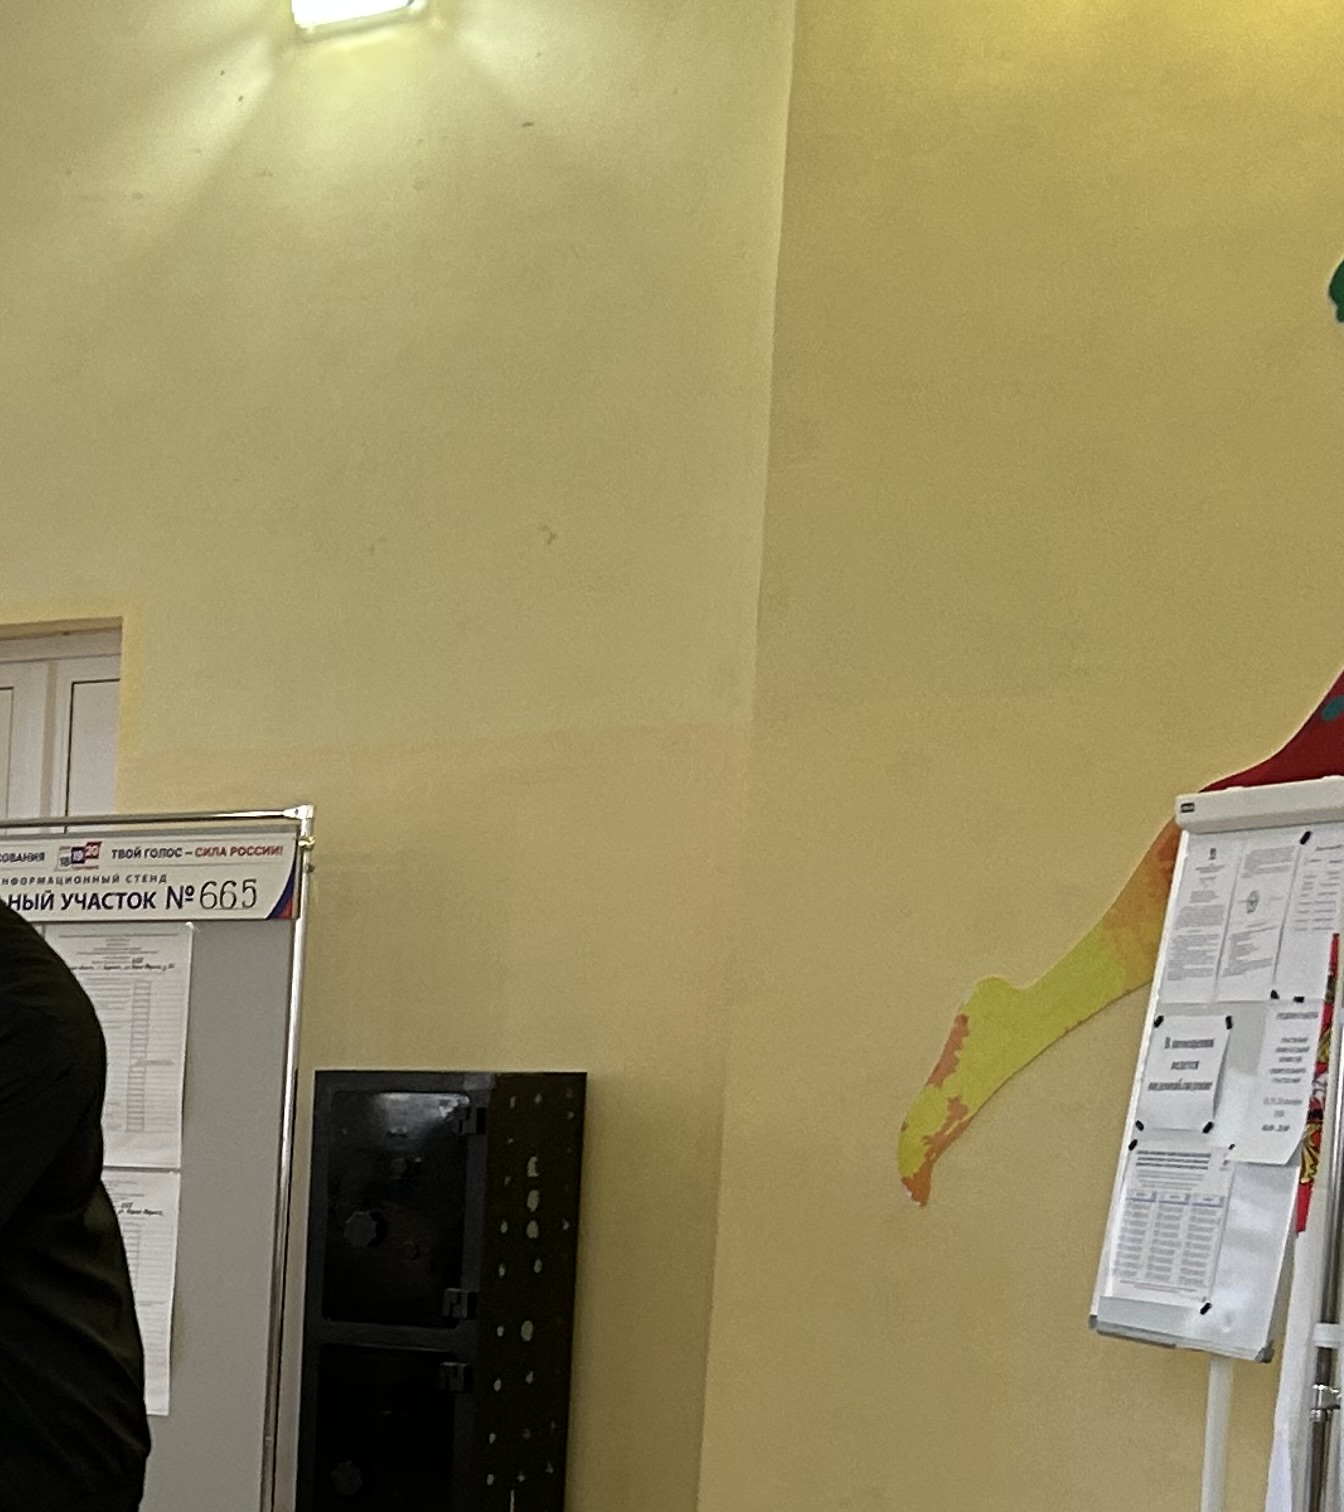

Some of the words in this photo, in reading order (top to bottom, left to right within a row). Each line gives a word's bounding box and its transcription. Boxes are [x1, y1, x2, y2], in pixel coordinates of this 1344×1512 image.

[111, 846, 142, 859] ТВОЙ
[144, 847, 183, 859] ГОЛОС
[194, 846, 227, 858] СИЛА
[229, 845, 284, 858] РОССИИ!
[126, 872, 168, 884] СТЕНД
[7, 889, 55, 911] НЫЙ
[60, 890, 157, 912] УЧАСТОК
[166, 885, 195, 910] №
[199, 878, 257, 911] 665
